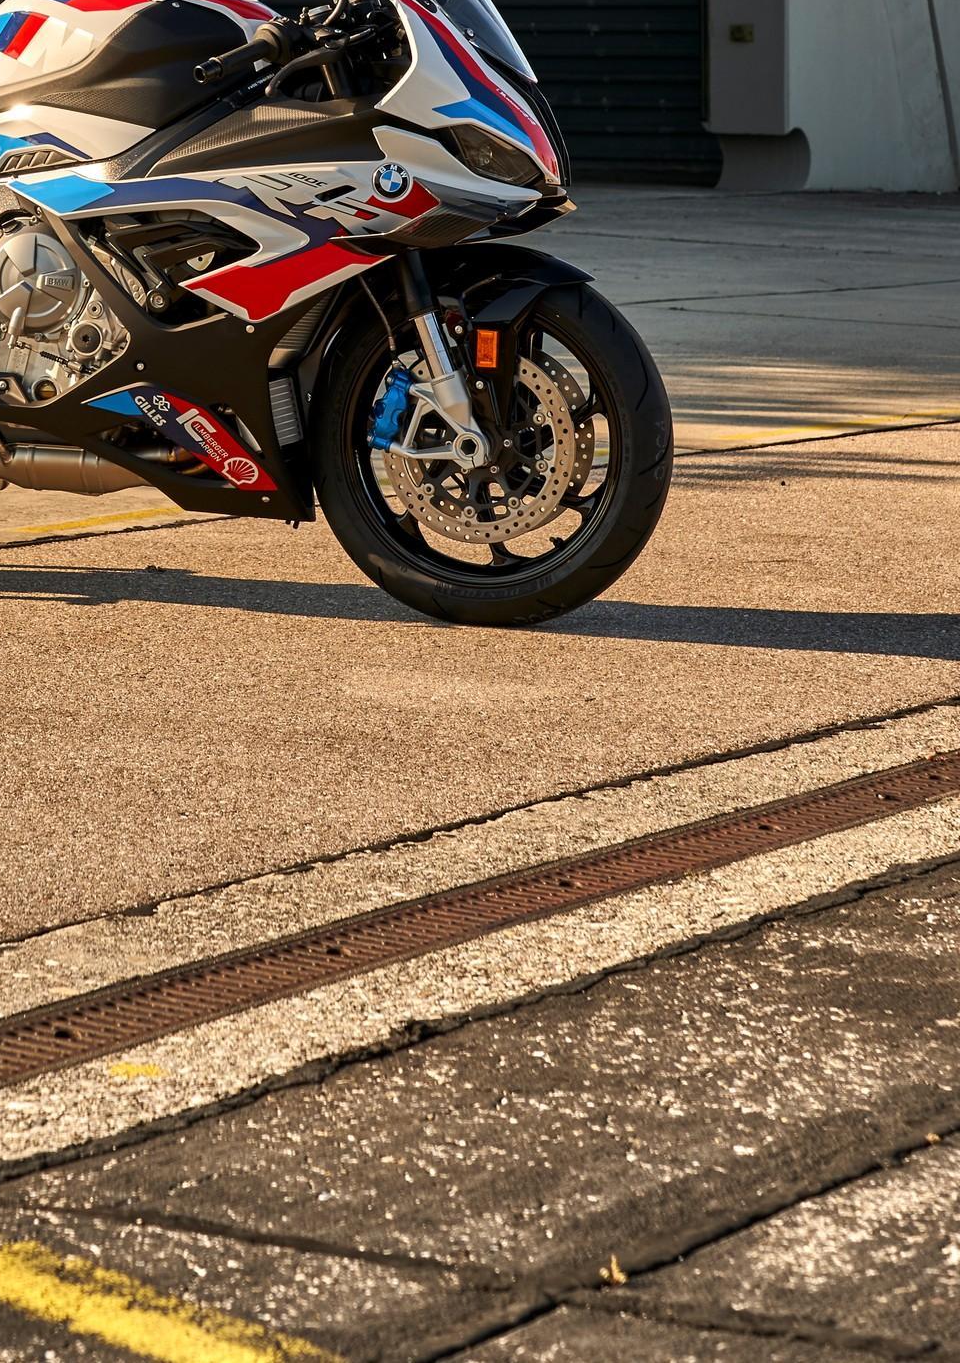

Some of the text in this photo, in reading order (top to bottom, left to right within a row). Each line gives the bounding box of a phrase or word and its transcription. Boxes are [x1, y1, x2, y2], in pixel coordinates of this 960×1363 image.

[378, 164, 408, 178] BMW
[134, 395, 167, 426] GILLES
[192, 423, 229, 459] ILMBERGER
